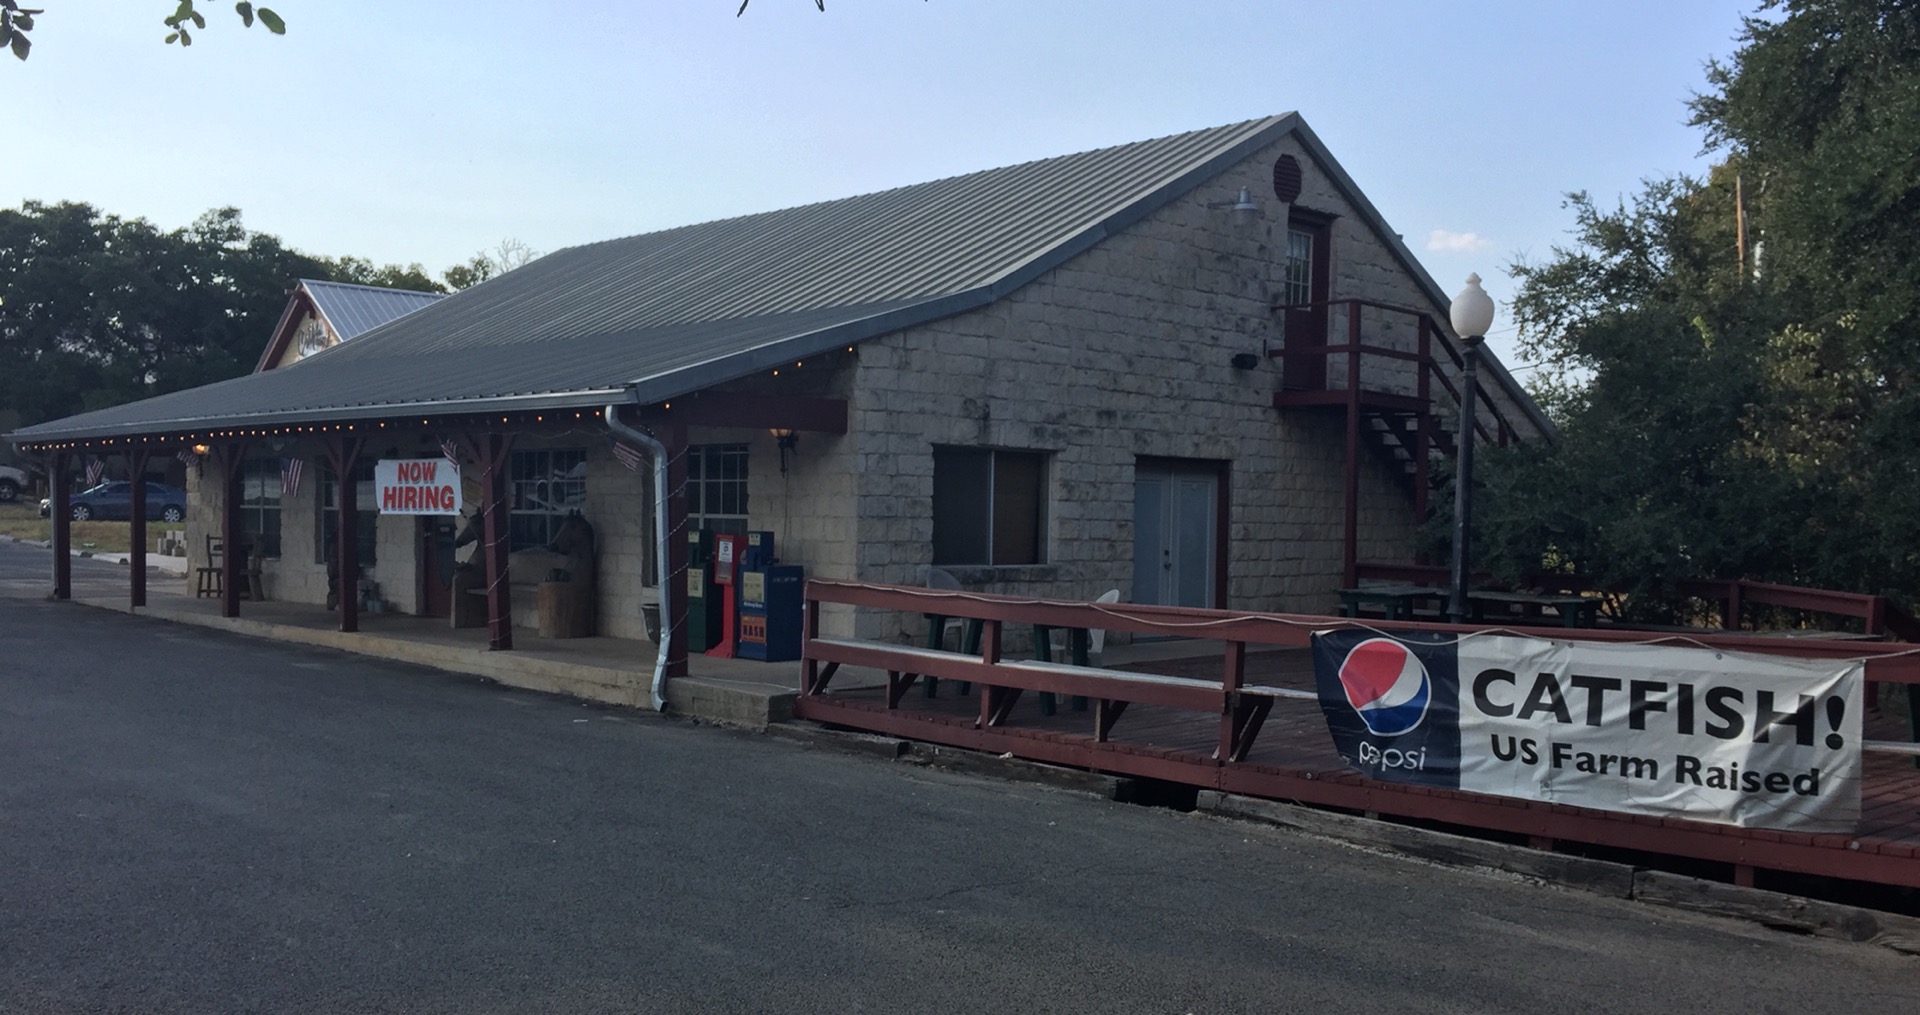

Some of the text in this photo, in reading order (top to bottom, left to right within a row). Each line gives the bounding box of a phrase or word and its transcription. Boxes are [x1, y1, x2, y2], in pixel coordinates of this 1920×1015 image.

[397, 462, 437, 484] NOW
[383, 485, 455, 512] HIRING
[1472, 668, 1847, 751] CATFISH!
[1358, 740, 1427, 772] pepsi
[1490, 734, 1821, 798] US Farm Raised
